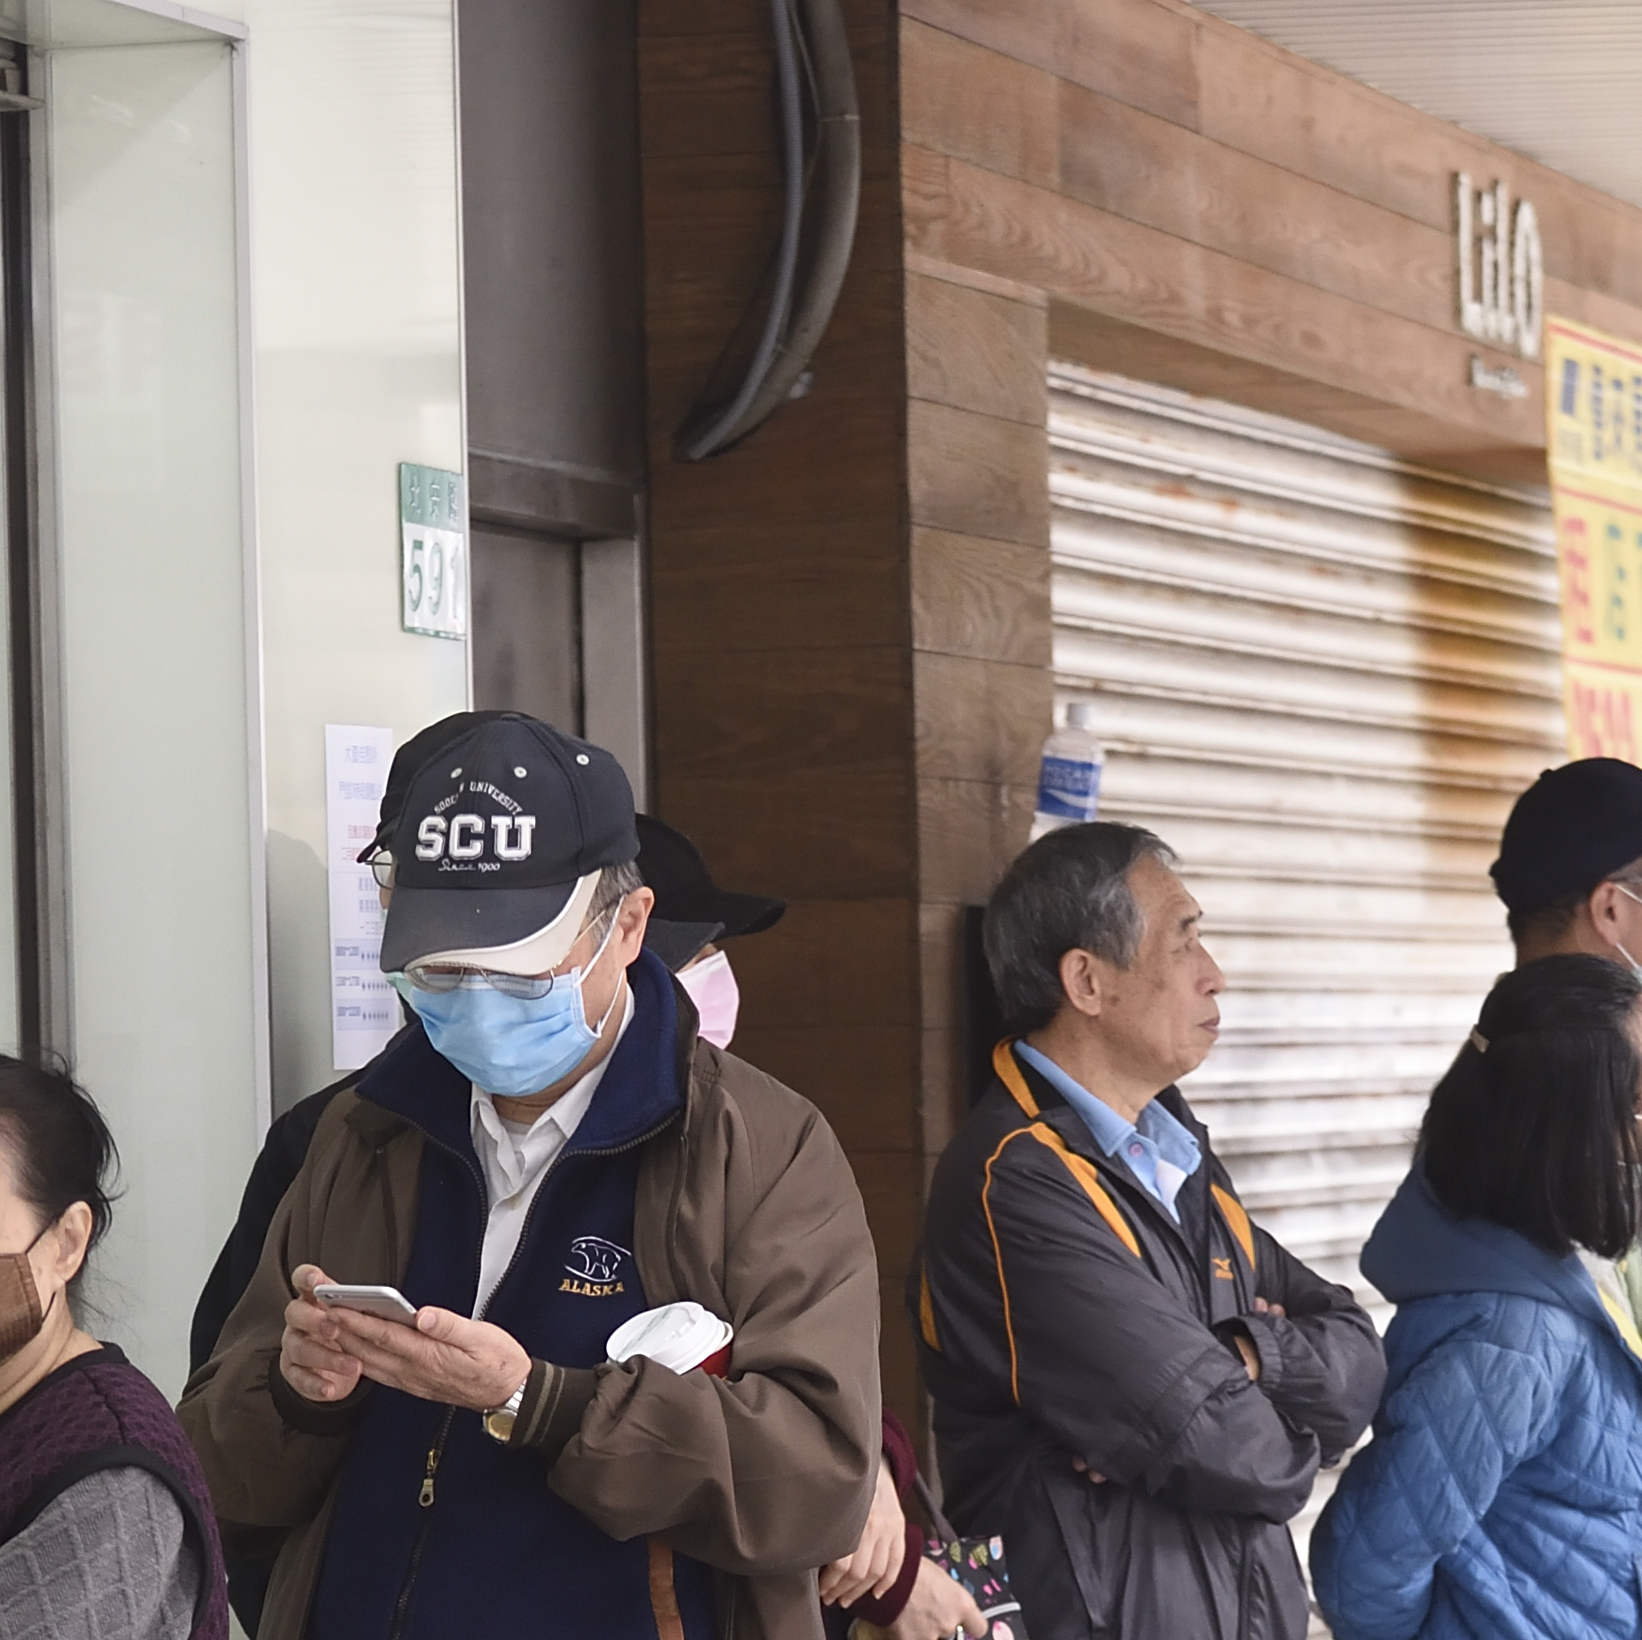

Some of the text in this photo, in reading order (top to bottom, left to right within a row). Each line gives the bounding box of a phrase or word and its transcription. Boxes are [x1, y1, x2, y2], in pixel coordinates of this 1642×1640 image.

[469, 781, 523, 815] UNIVERSITY
[415, 814, 536, 861] SCU
[558, 1277, 624, 1297] ALASKA
